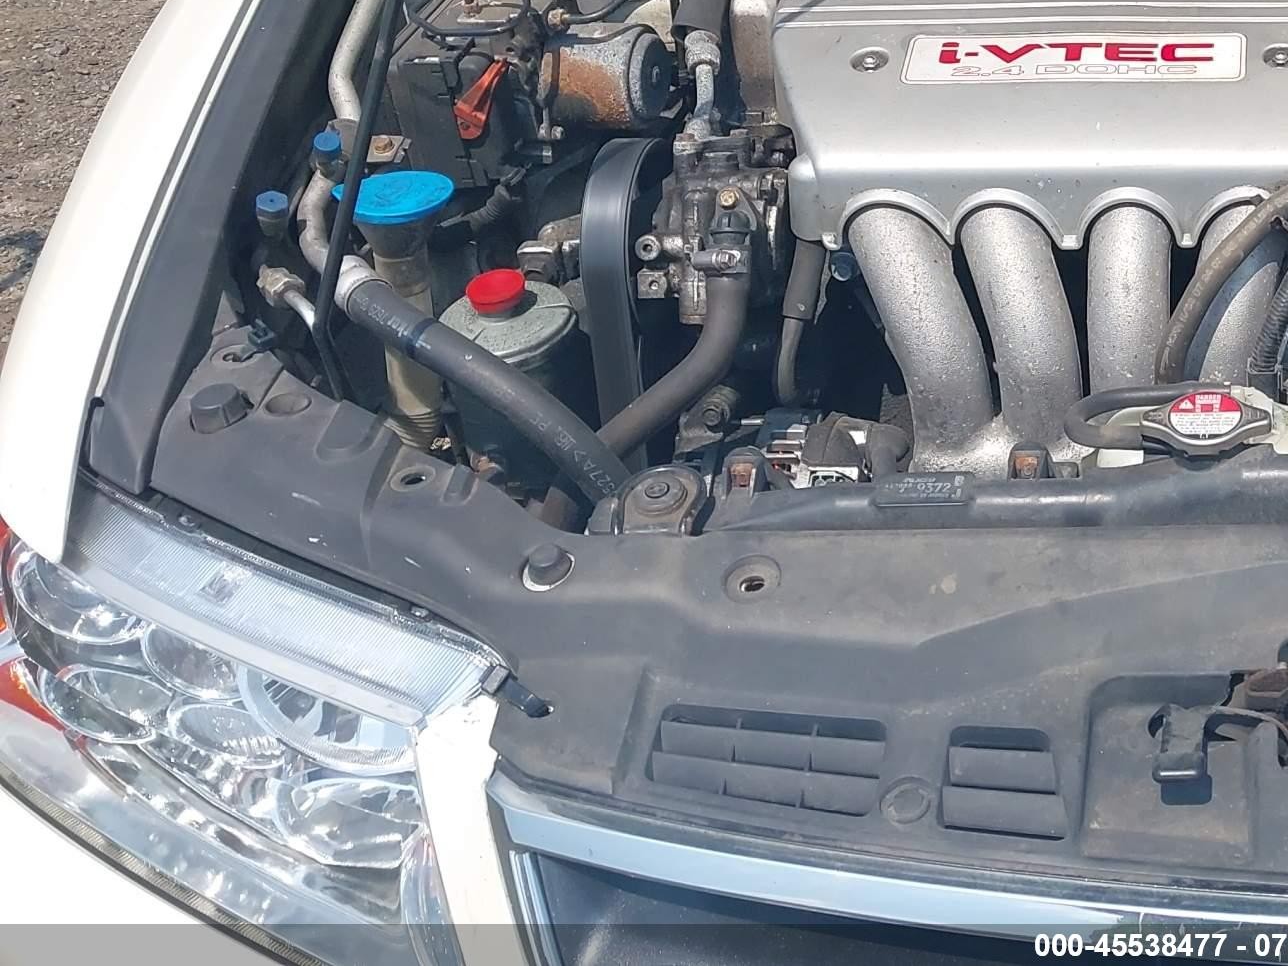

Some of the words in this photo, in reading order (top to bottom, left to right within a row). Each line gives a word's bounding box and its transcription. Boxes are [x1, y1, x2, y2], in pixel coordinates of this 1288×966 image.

[939, 41, 1215, 65] i-VTEC
[951, 64, 1025, 77] 2.4
[1035, 64, 1198, 76] DOHC
